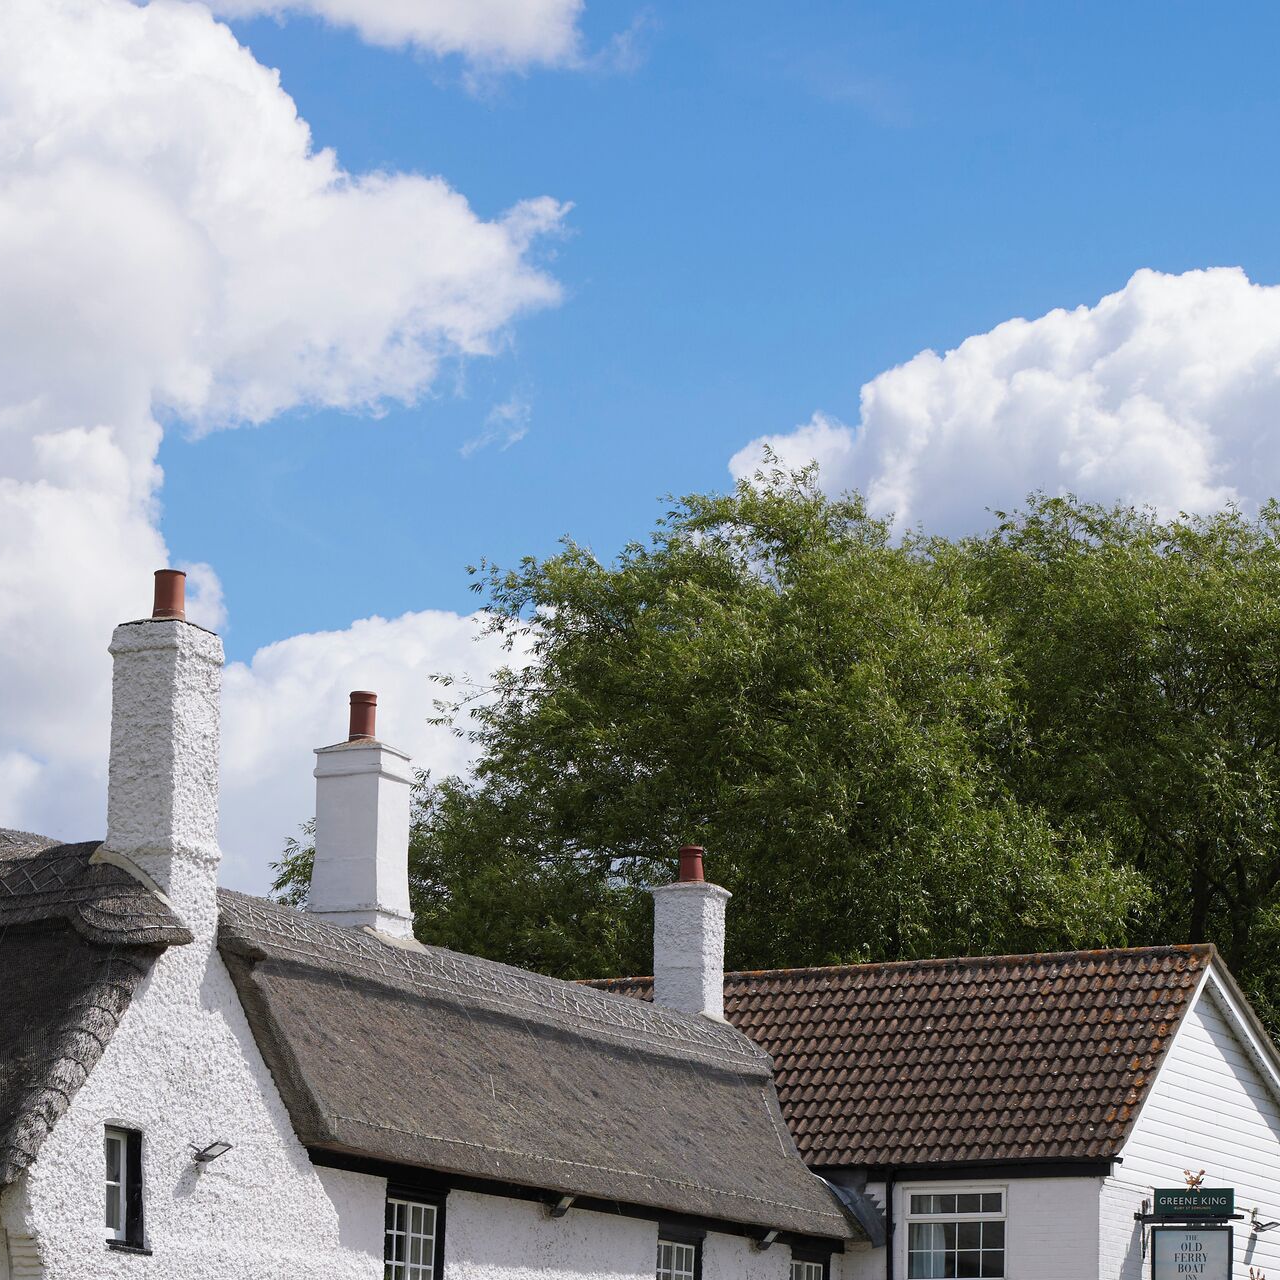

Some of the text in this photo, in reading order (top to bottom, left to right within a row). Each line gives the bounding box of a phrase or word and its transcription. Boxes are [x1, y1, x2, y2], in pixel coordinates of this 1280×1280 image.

[1159, 1197, 1227, 1205] GREENE KING
[1181, 1242, 1203, 1252] OLD
[1174, 1253, 1208, 1262] FERRY
[1178, 1263, 1205, 1273] BOAT
